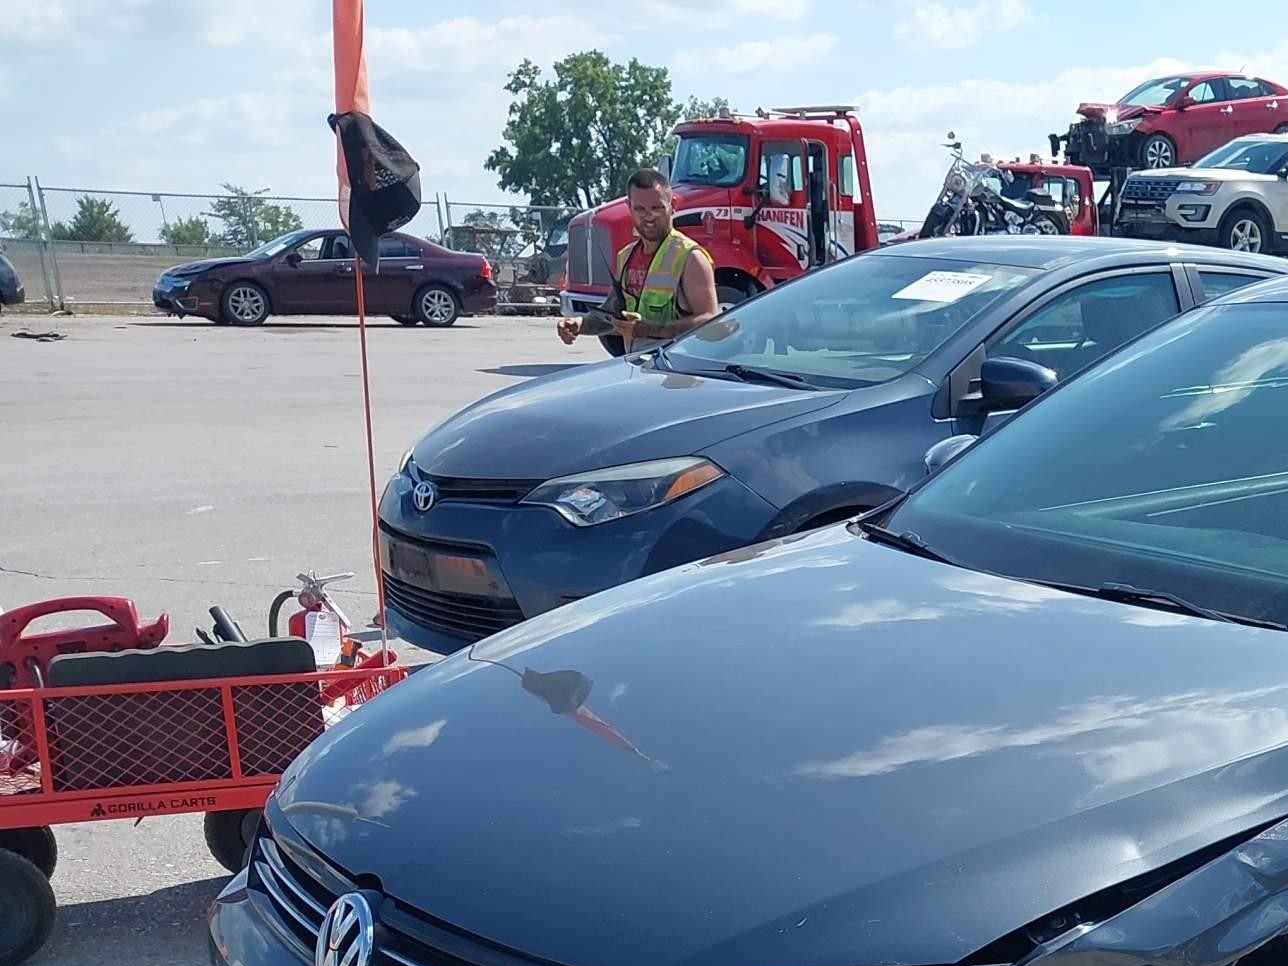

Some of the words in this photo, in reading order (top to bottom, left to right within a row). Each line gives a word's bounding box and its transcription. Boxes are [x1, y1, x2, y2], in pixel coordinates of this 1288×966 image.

[716, 208, 729, 218] 73
[757, 209, 805, 231] HANIFEN
[108, 801, 167, 815] GORILLA
[170, 796, 217, 809] CARTS
